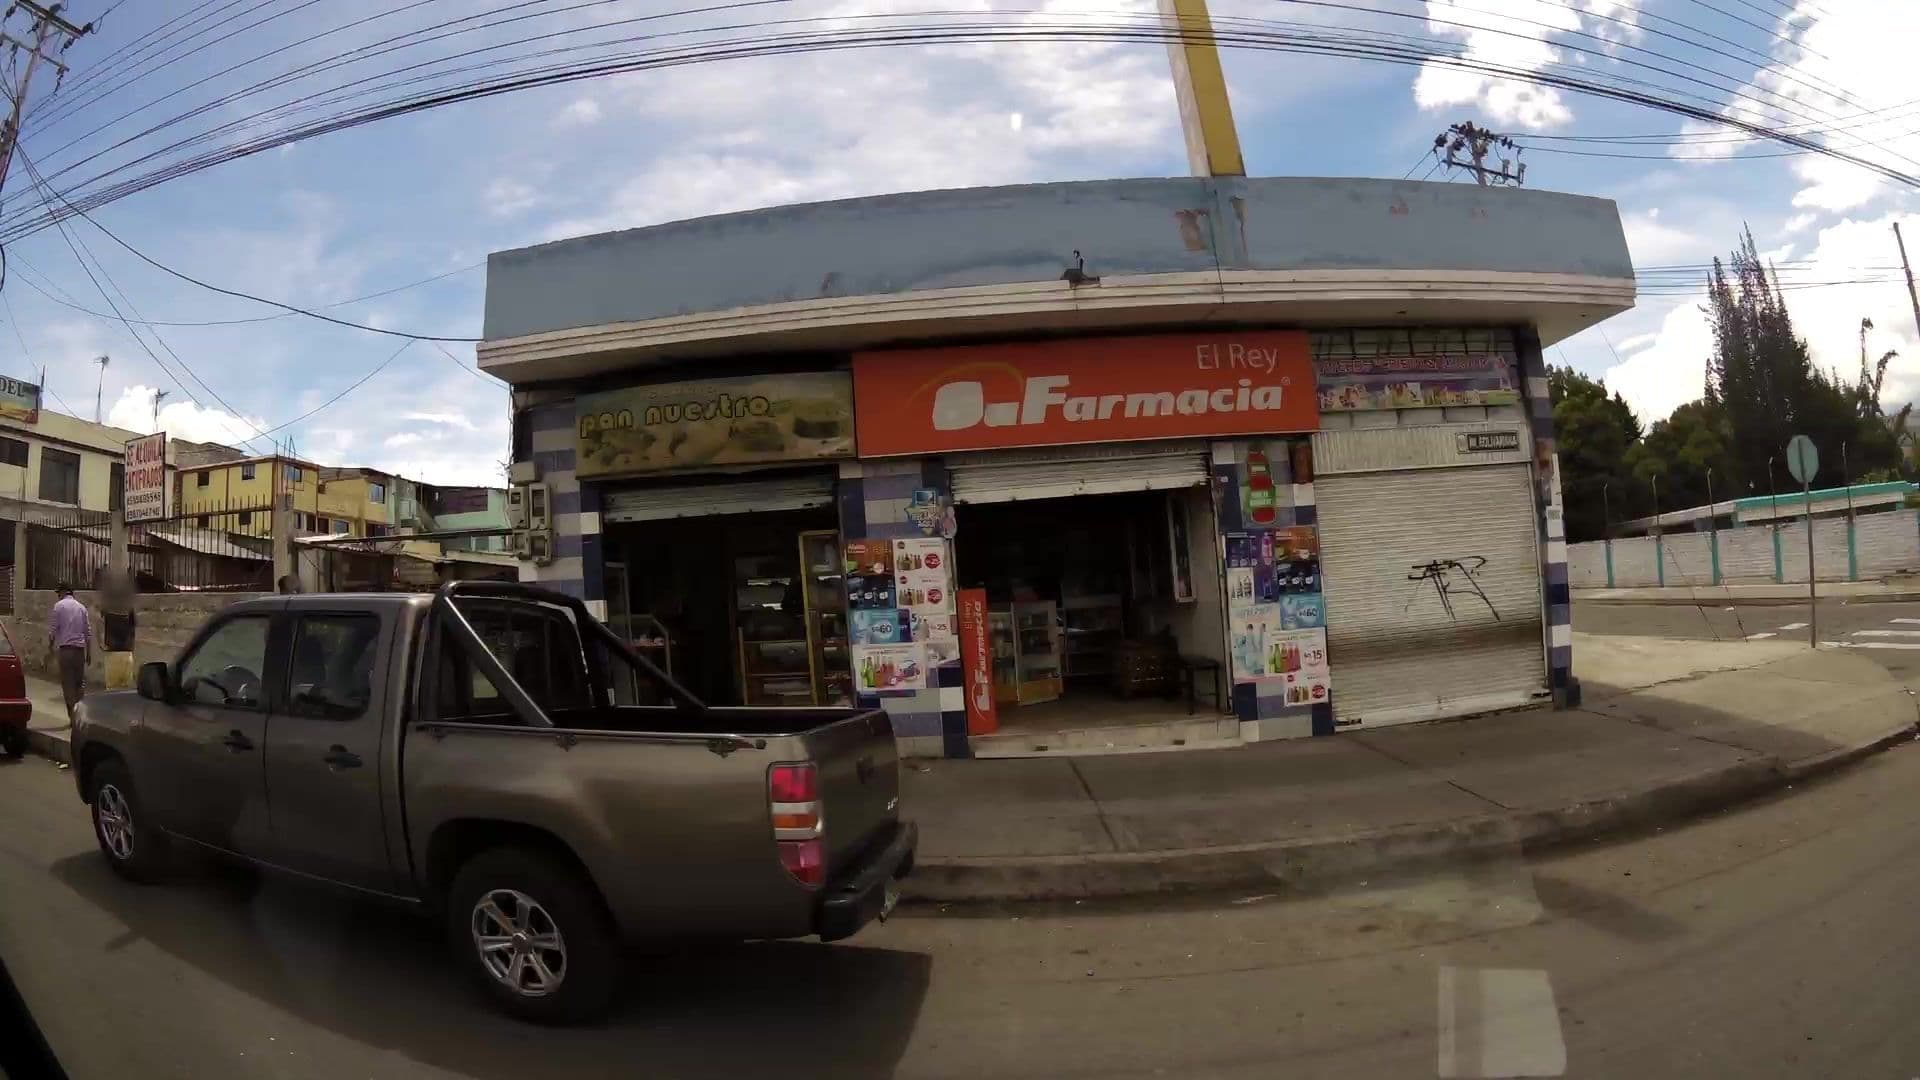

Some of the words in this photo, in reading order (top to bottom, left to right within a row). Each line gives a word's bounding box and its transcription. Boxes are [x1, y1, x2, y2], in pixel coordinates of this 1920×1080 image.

[1196, 343, 1220, 370] El
[1228, 343, 1278, 374] Rey
[1020, 375, 1284, 425] Farmacia
[579, 408, 633, 439] pan
